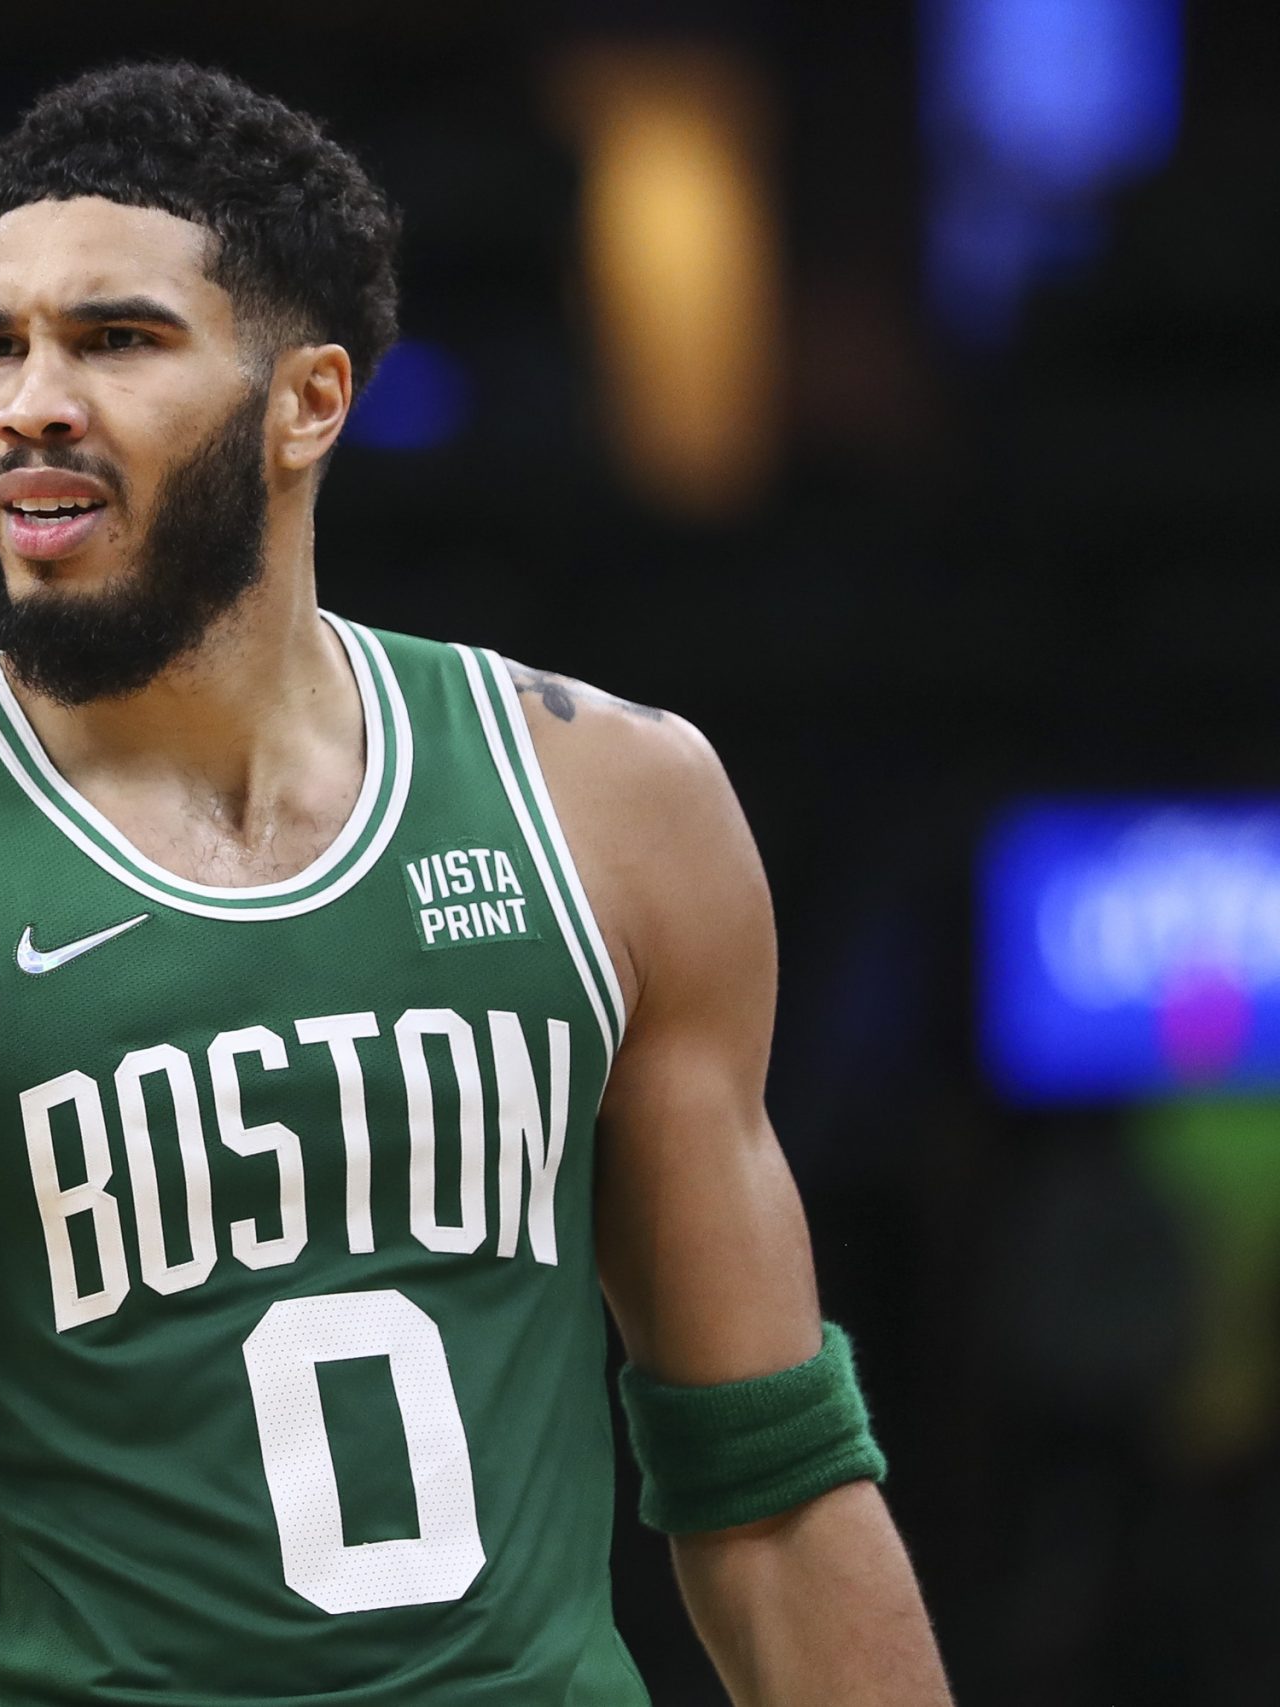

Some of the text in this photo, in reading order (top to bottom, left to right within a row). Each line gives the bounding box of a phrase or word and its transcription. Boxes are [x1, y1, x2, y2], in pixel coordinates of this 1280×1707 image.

[406, 848, 524, 906] VISTA
[419, 898, 527, 945] PRINT
[18, 1007, 571, 1335] BOSTON
[241, 1288, 488, 1615] 0
